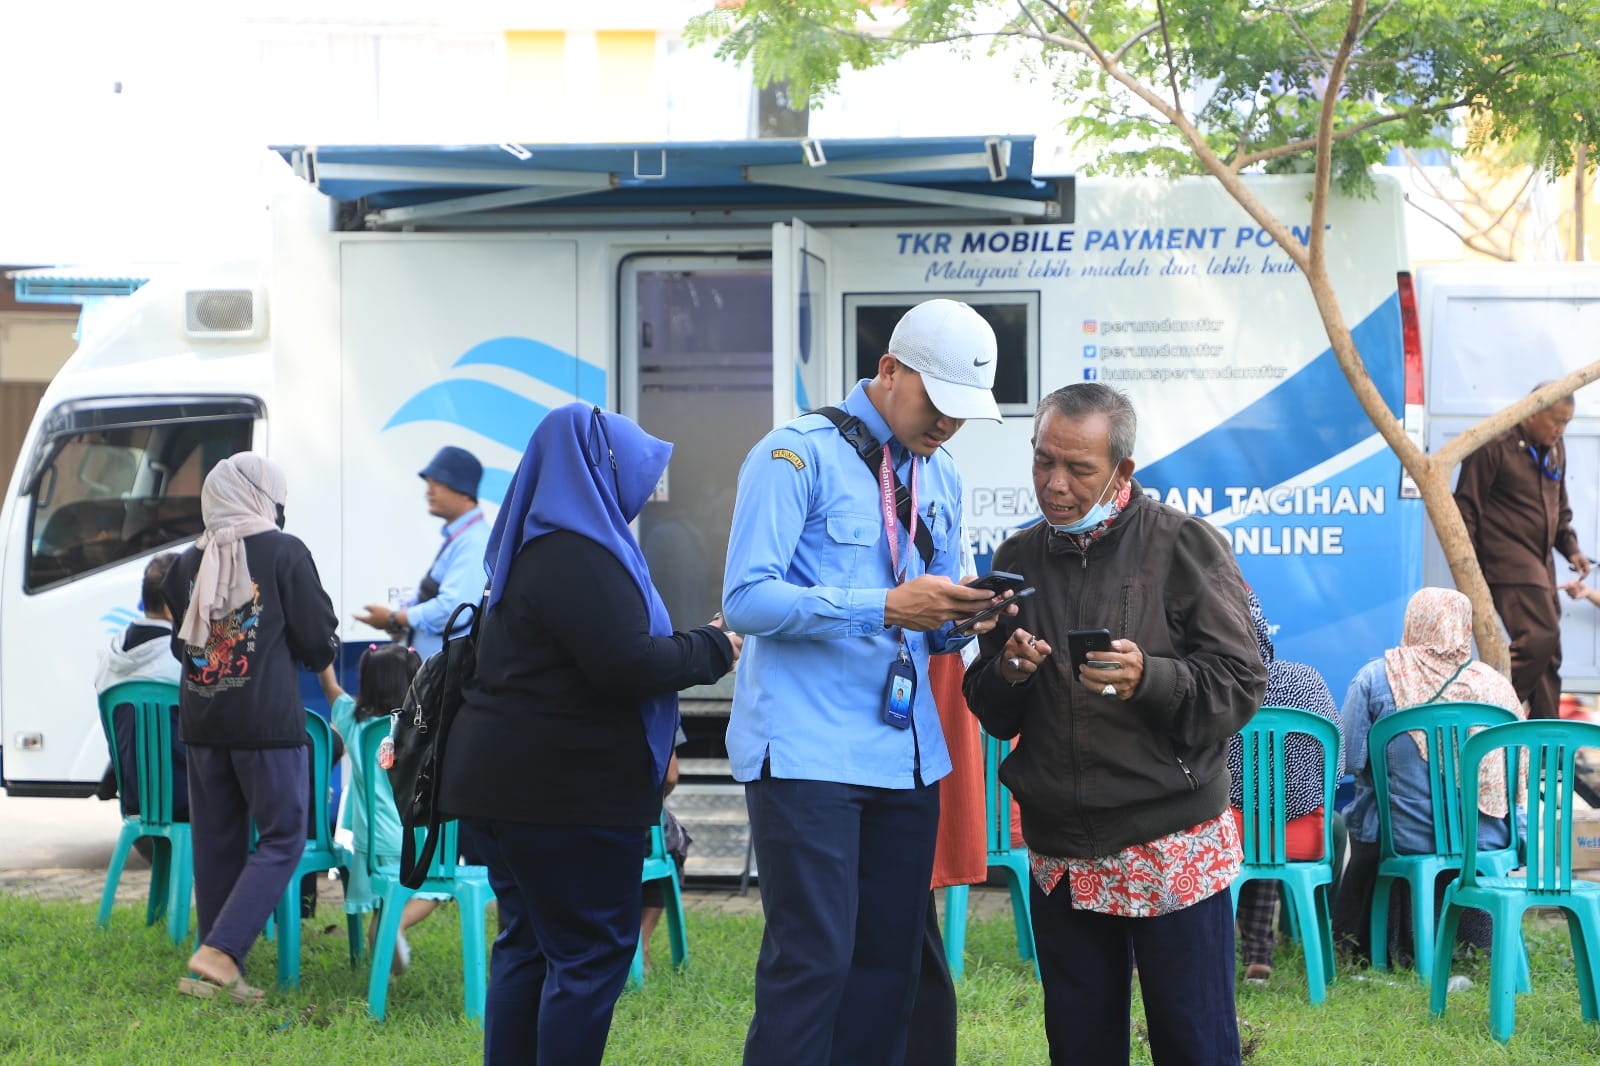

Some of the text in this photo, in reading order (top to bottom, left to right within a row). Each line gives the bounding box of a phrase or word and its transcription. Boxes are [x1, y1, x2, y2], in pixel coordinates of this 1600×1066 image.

[896, 225, 1331, 254] TKR MOBILE PAYMENT PON
[924, 260, 1023, 287] Melayani
[1027, 259, 1072, 278] lebih
[1081, 257, 1150, 277] mudah
[1159, 256, 1197, 277] dan
[1206, 256, 1250, 275] lebih
[1224, 486, 1385, 515] TAGIHAN
[1219, 526, 1344, 555] NLINE
